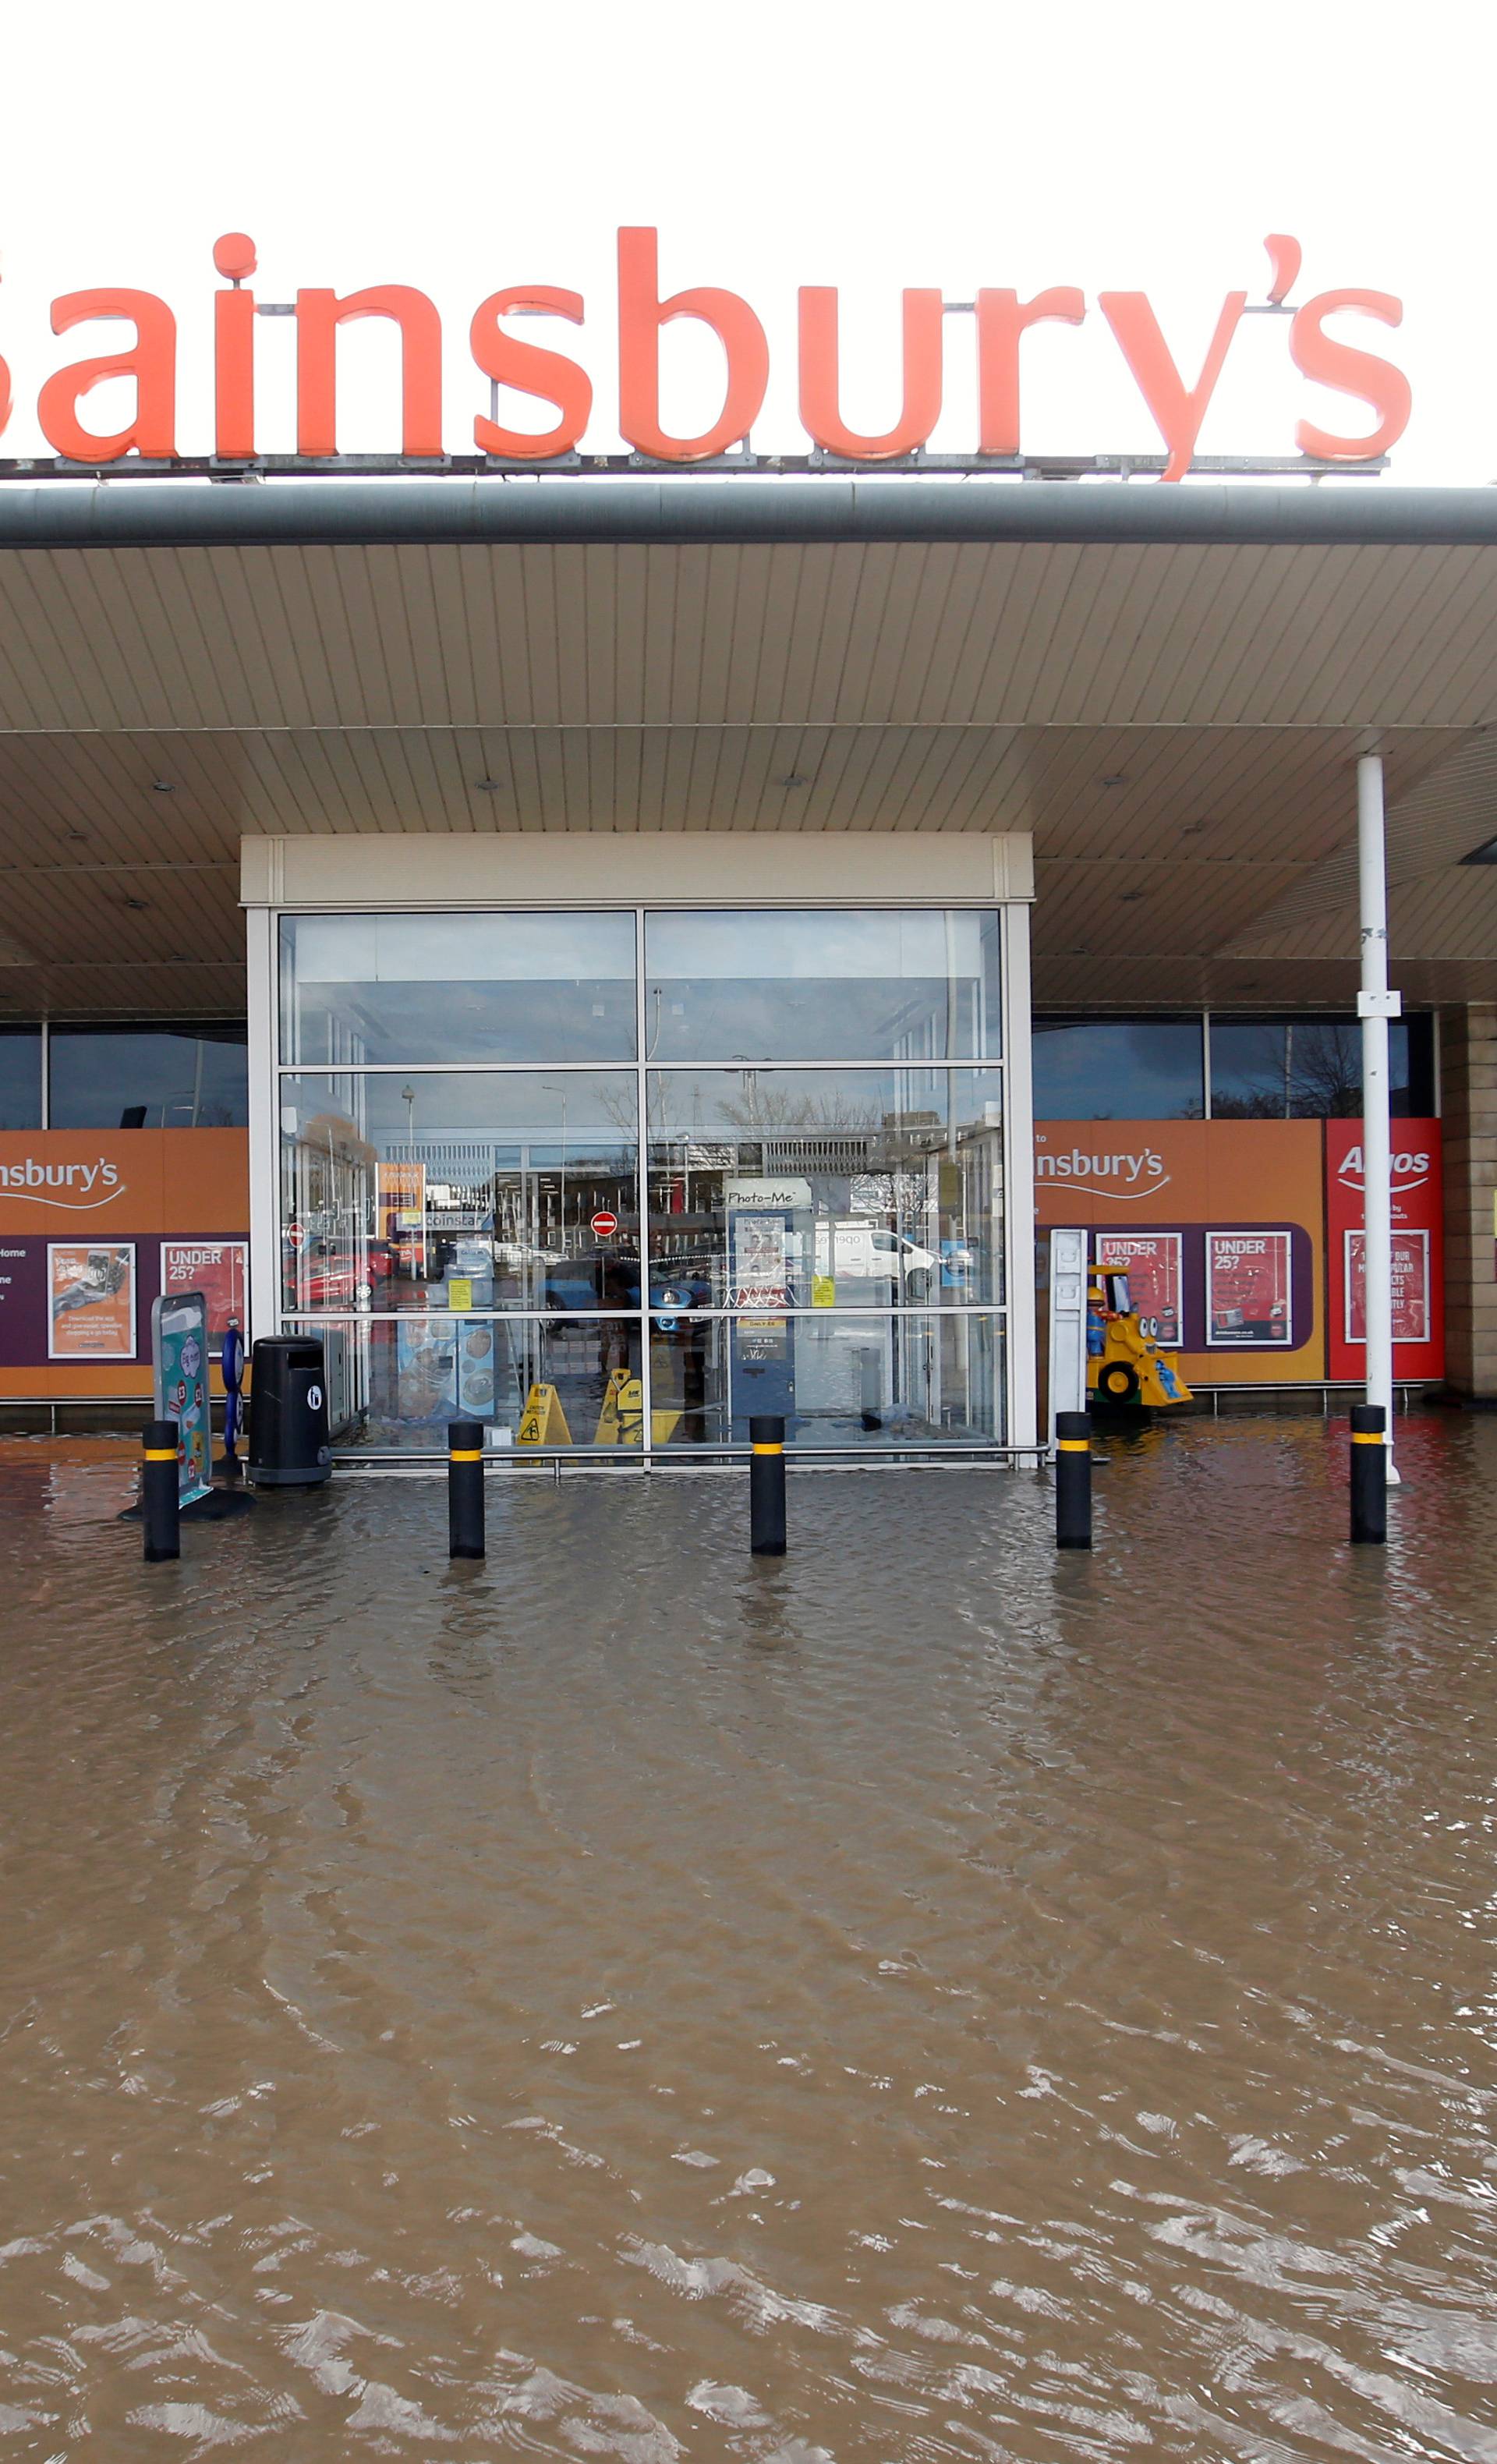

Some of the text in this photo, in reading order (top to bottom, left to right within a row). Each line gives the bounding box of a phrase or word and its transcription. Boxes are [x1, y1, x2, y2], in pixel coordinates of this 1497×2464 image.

[0, 225, 1412, 482] ainsbury's
[1036, 1135, 1046, 1143] to
[1338, 1146, 1430, 1174] Aos
[728, 1192, 793, 1204] Photo-Me
[426, 1214, 481, 1227] coinstar
[1106, 1241, 1157, 1255] UNDER
[1215, 1240, 1265, 1254] UNDER
[169, 1250, 222, 1264] UNDER
[1215, 1255, 1240, 1269] 25?
[169, 1266, 195, 1280] 25?
